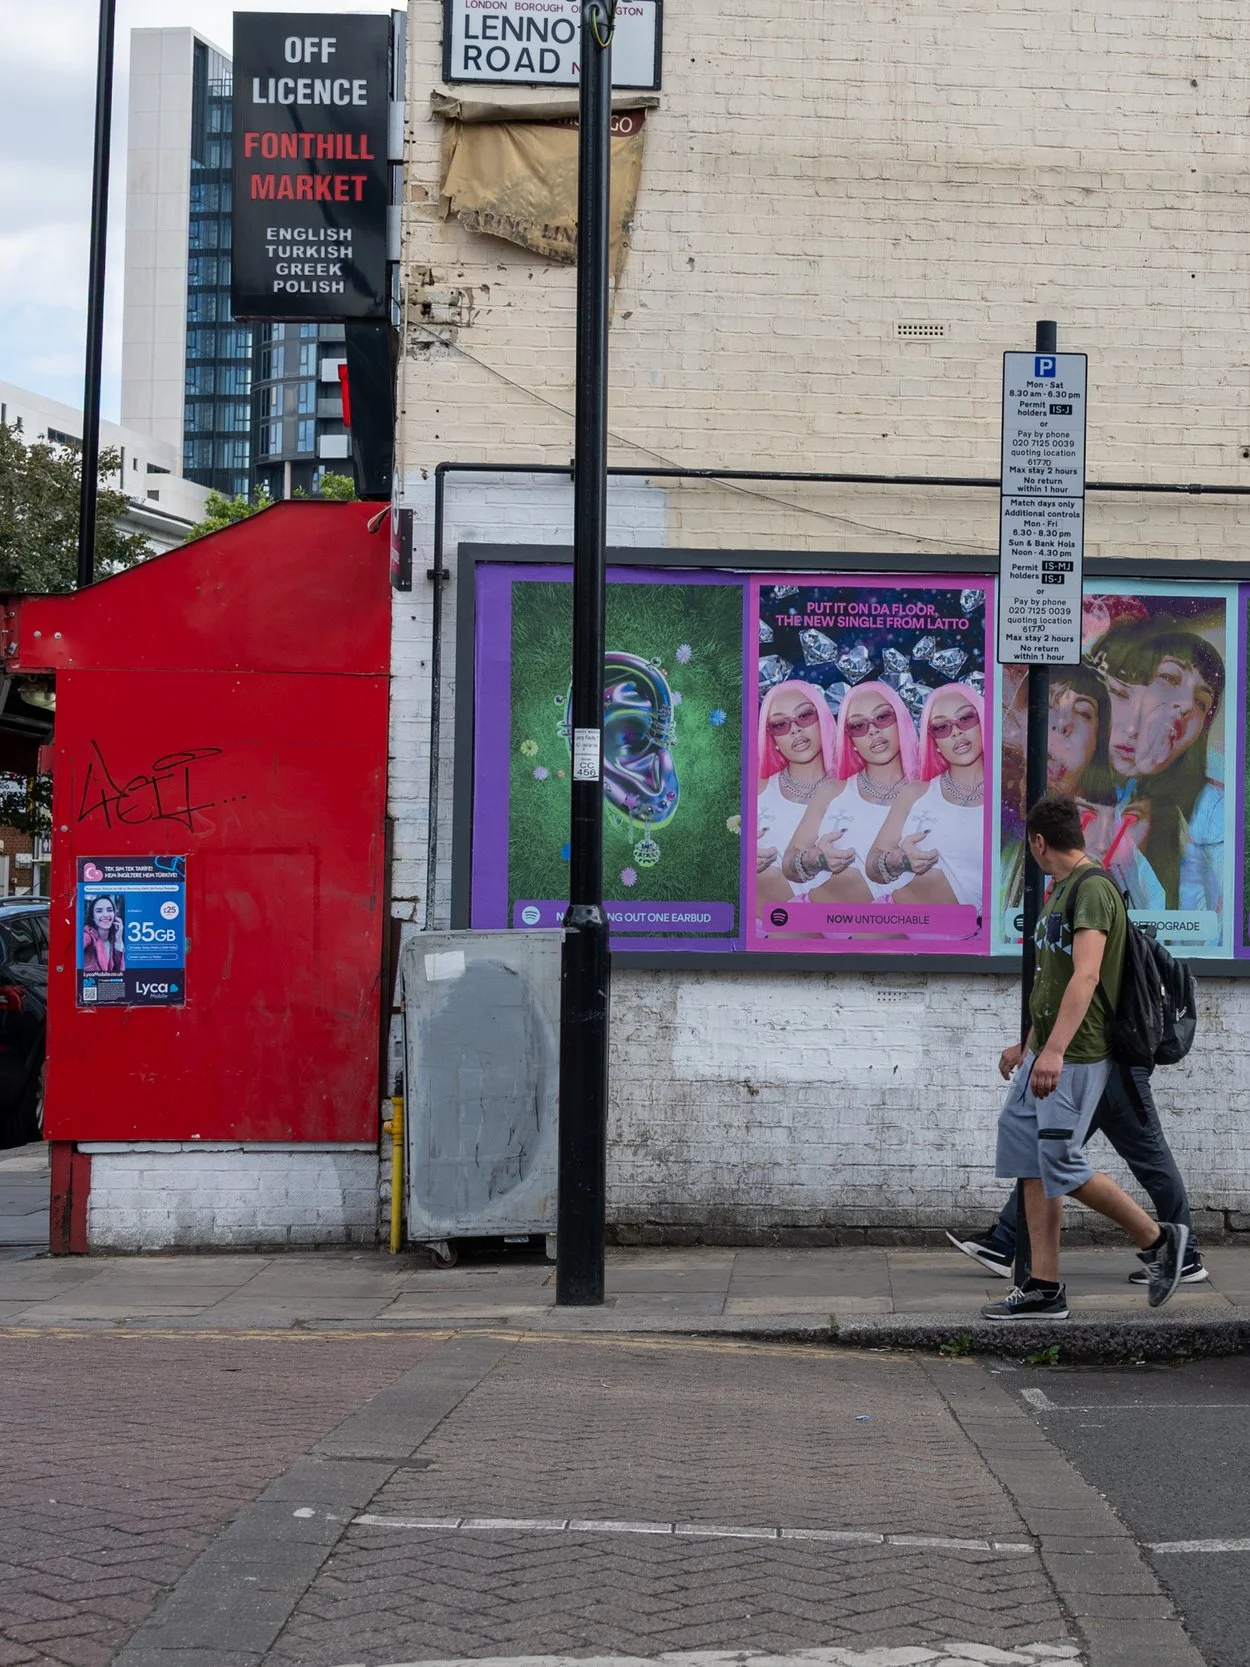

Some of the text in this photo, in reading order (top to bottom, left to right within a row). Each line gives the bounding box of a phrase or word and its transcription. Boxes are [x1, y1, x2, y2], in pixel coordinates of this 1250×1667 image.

[465, 0, 581, 13] LONDON BOROUGH O
[464, 14, 576, 44] LENNO
[284, 36, 336, 64] OFF
[464, 45, 581, 75] ROAD N
[252, 78, 368, 106] LICENCE
[244, 132, 374, 160] FONTHILL
[250, 174, 368, 201] MARKET
[266, 227, 352, 241] ENGLISH
[265, 245, 353, 259] TURKISH
[275, 263, 342, 276] GREEK
[273, 280, 345, 293] POLISH
[1040, 359, 1053, 376] P
[1026, 381, 1043, 389] Mon
[1050, 381, 1064, 389] Sat
[1009, 389, 1028, 397] 8.30
[1047, 390, 1066, 398] 6.30
[1017, 409, 1047, 417] holders
[1017, 430, 1070, 439] Pay by phone
[1012, 439, 1029, 447] 020
[1052, 440, 1075, 448] 0039
[1011, 449, 1076, 458] quoting location
[1009, 466, 1026, 474] Max
[1028, 467, 1045, 475] stay
[1055, 467, 1077, 475] hours
[1017, 485, 1042, 493] within
[1010, 499, 1075, 509] Match days only
[1004, 509, 1080, 518] Additional controls
[1038, 549, 1058, 557] 4.30
[1012, 563, 1038, 571] Permit
[1010, 572, 1039, 580] holders
[1014, 597, 1066, 607] Pay by phone
[807, 602, 939, 618] PUT IT ON DA FLOOR,
[1049, 607, 1071, 615] 0039
[776, 615, 969, 630] THE NEW SINGLE FROM LATTO
[1007, 616, 1037, 625] quoting
[1025, 635, 1041, 643] stay
[1052, 635, 1074, 643] hours
[624, 913, 646, 922] OUT
[648, 913, 670, 923] ONE
[671, 913, 711, 923] EARBUD
[826, 914, 929, 925] NOW UNTOUCHABLE
[136, 981, 169, 996] Lyca
